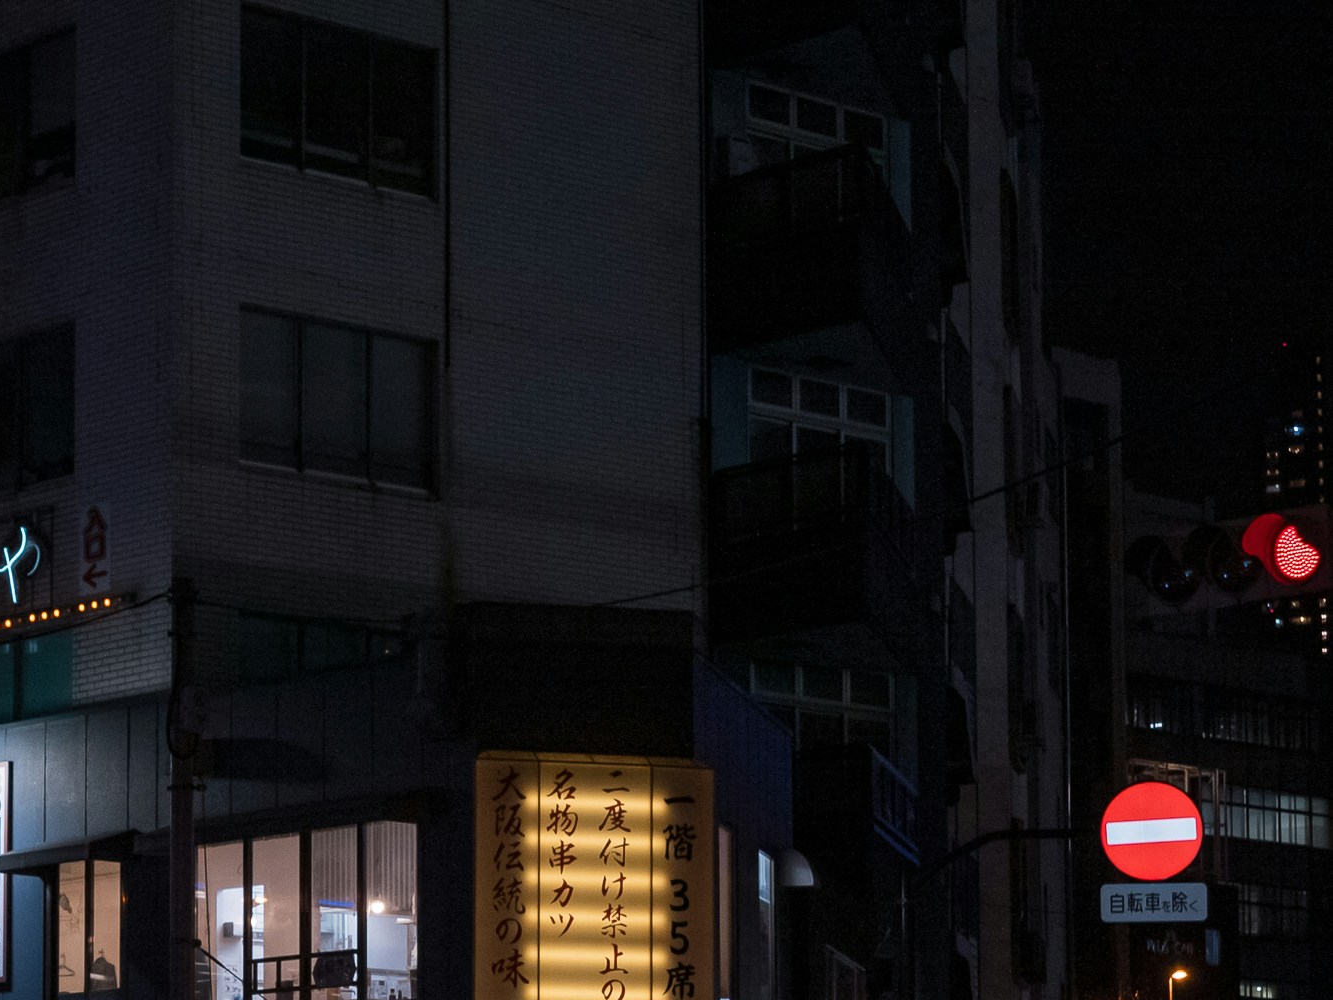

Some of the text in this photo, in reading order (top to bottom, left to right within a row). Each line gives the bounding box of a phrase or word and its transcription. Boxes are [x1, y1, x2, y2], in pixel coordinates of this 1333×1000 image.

[84, 505, 107, 562] 入口
[491, 764, 530, 988] 大阪伝統の味
[546, 768, 579, 938] 名物串カツ
[662, 795, 697, 1000] 一階35席
[1110, 891, 1199, 914] 自転車を除く
